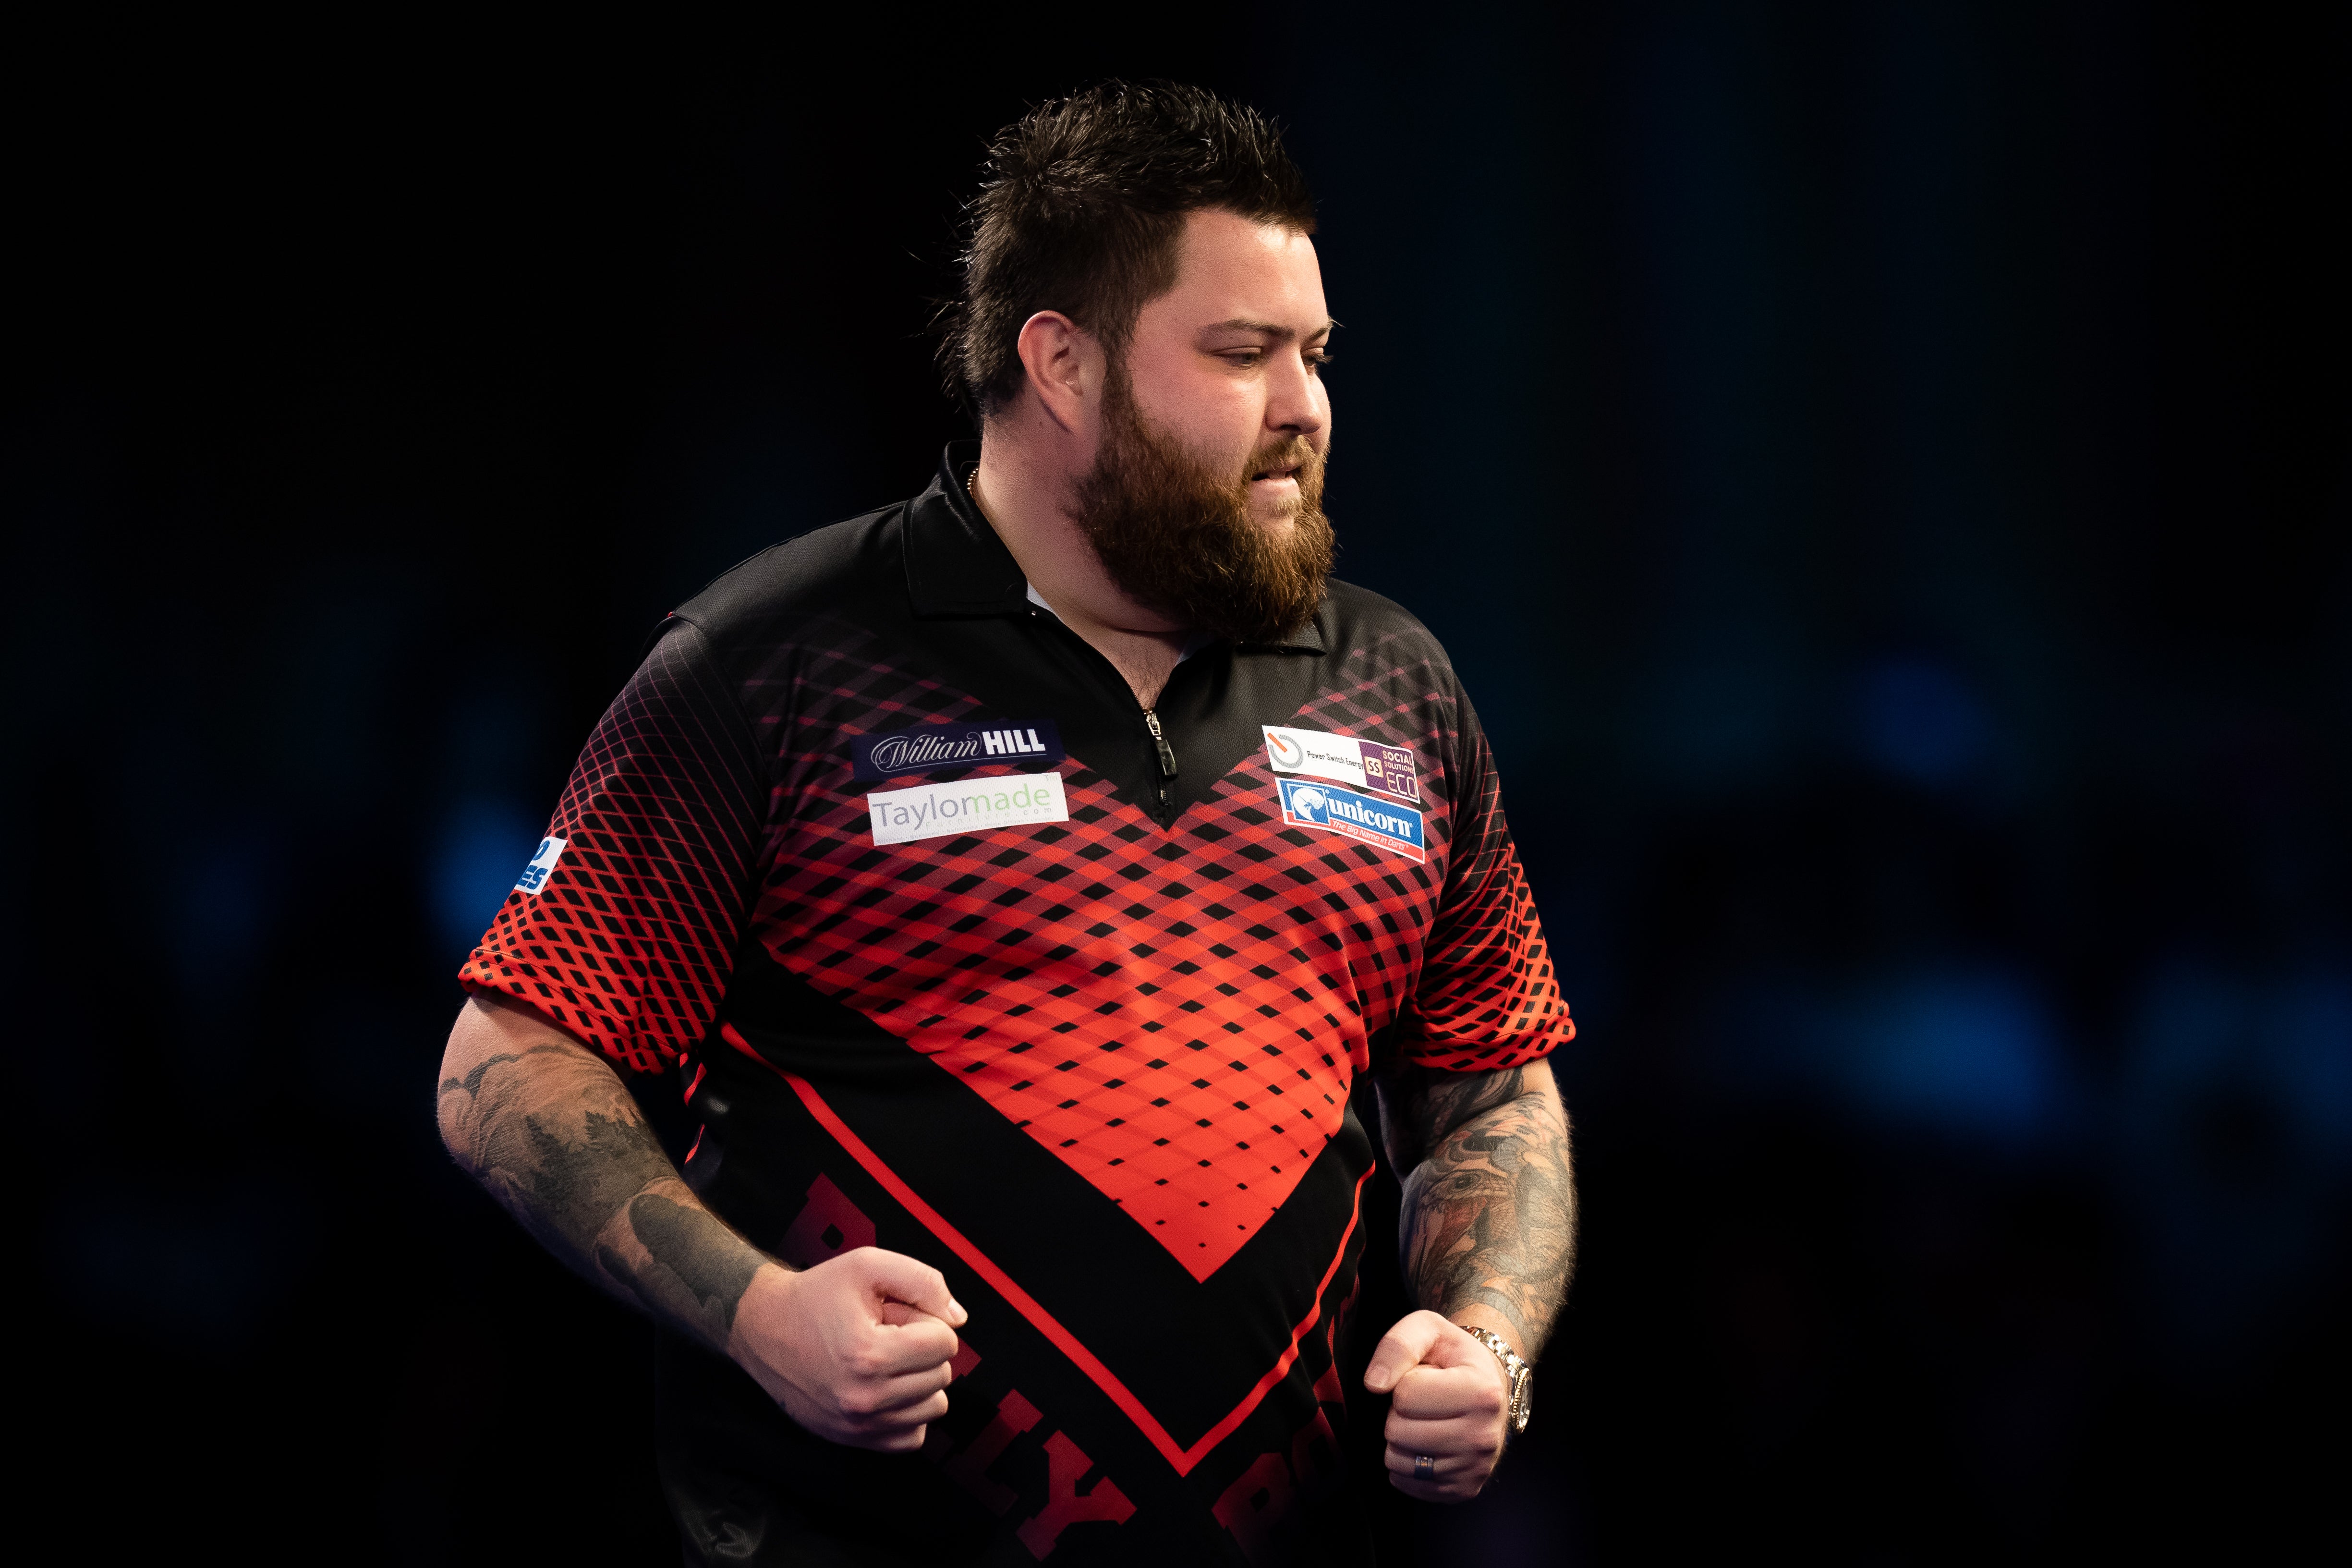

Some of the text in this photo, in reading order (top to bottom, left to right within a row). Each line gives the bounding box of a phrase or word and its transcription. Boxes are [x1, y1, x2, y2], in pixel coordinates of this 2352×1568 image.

[871, 729, 1045, 772] William HILL
[1307, 751, 1363, 769] Power Switch Energy
[1382, 750, 1413, 766] SOCIAL
[1369, 761, 1380, 773] SS
[1386, 771, 1417, 798] ECO
[873, 783, 1050, 830] Taylormade
[1327, 801, 1411, 838] unicorn
[1333, 821, 1346, 830] The
[1347, 826, 1358, 835] Big
[1360, 829, 1379, 841] Name
[1388, 839, 1405, 851] Darts
